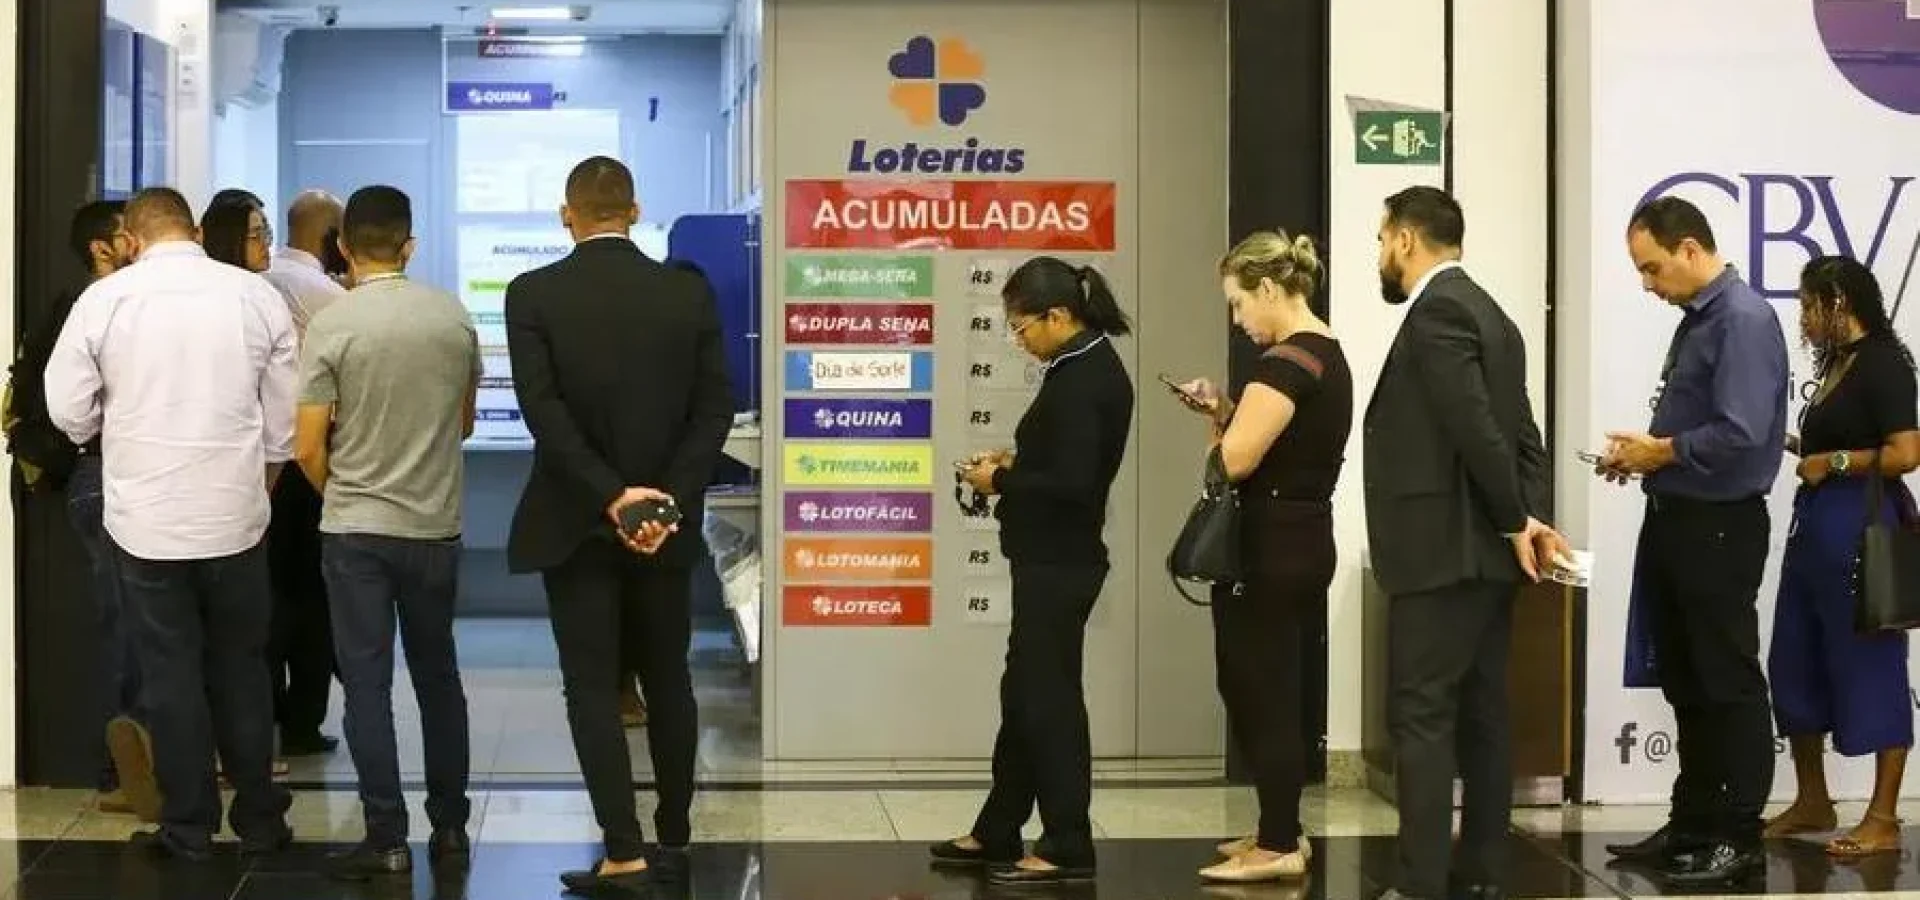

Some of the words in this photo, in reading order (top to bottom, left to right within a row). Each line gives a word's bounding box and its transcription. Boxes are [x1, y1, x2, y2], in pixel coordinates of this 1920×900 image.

[849, 138, 1025, 173] Loterias
[813, 200, 1090, 231] ACUMULADAS
[810, 317, 872, 331] DUPLA
[879, 316, 930, 332] SENA
[845, 361, 863, 377] de
[868, 360, 906, 379] Sorte
[836, 411, 903, 427] QUINA
[819, 460, 919, 473] TIMEMANIA
[817, 553, 920, 568] LOTOMANIA
[833, 600, 902, 614] LOTECA
